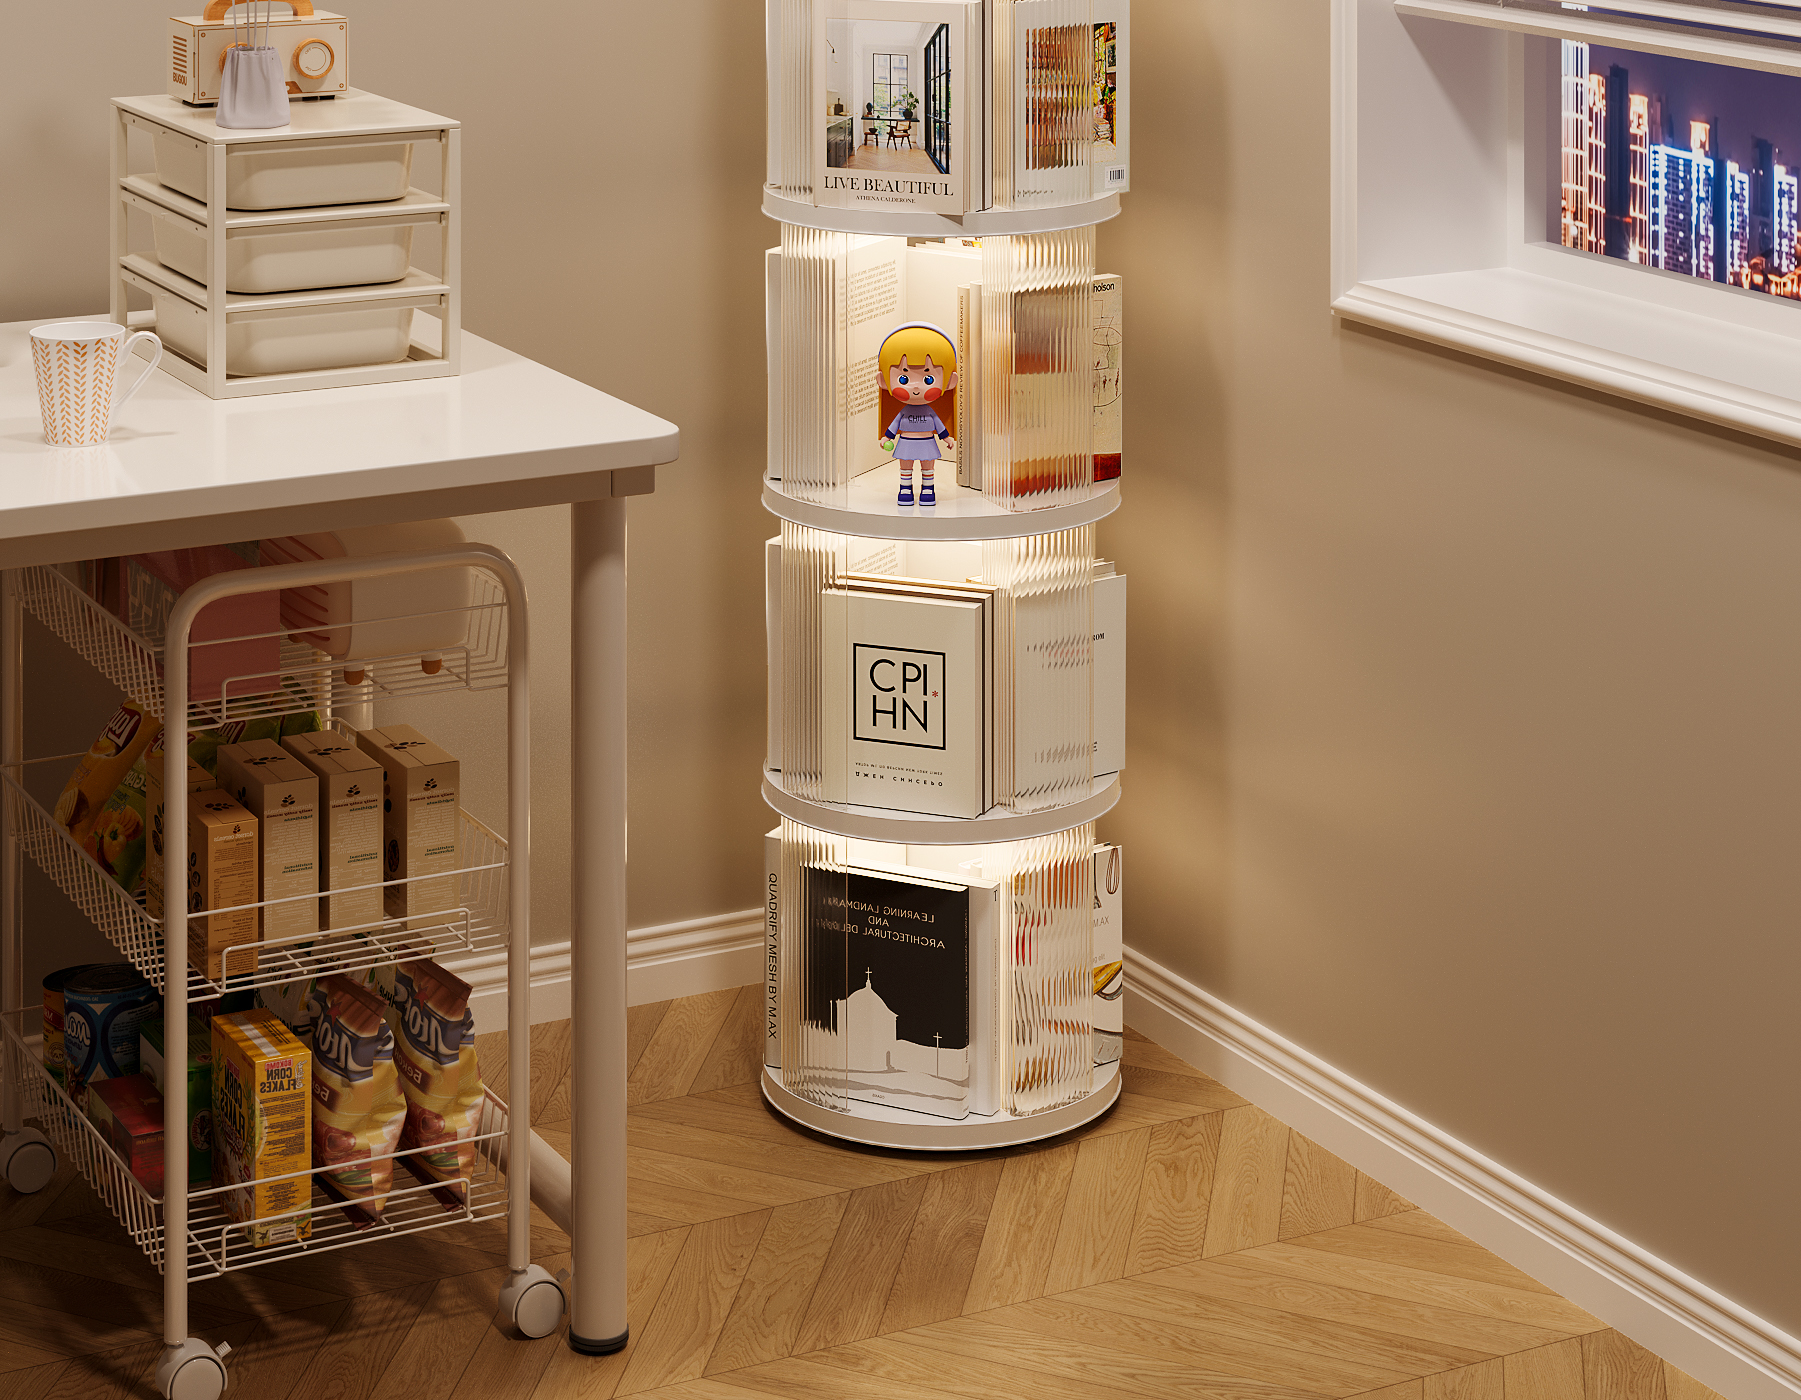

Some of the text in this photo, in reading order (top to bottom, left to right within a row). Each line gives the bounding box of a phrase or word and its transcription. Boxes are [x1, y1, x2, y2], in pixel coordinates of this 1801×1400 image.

[824, 175, 954, 196] LIVE BEAUTIFUL
[855, 194, 916, 204] ATHENA CALDERONE
[908, 414, 927, 422] CHILL
[768, 873, 778, 1039] QUADRIFY MESH BY M.AX
